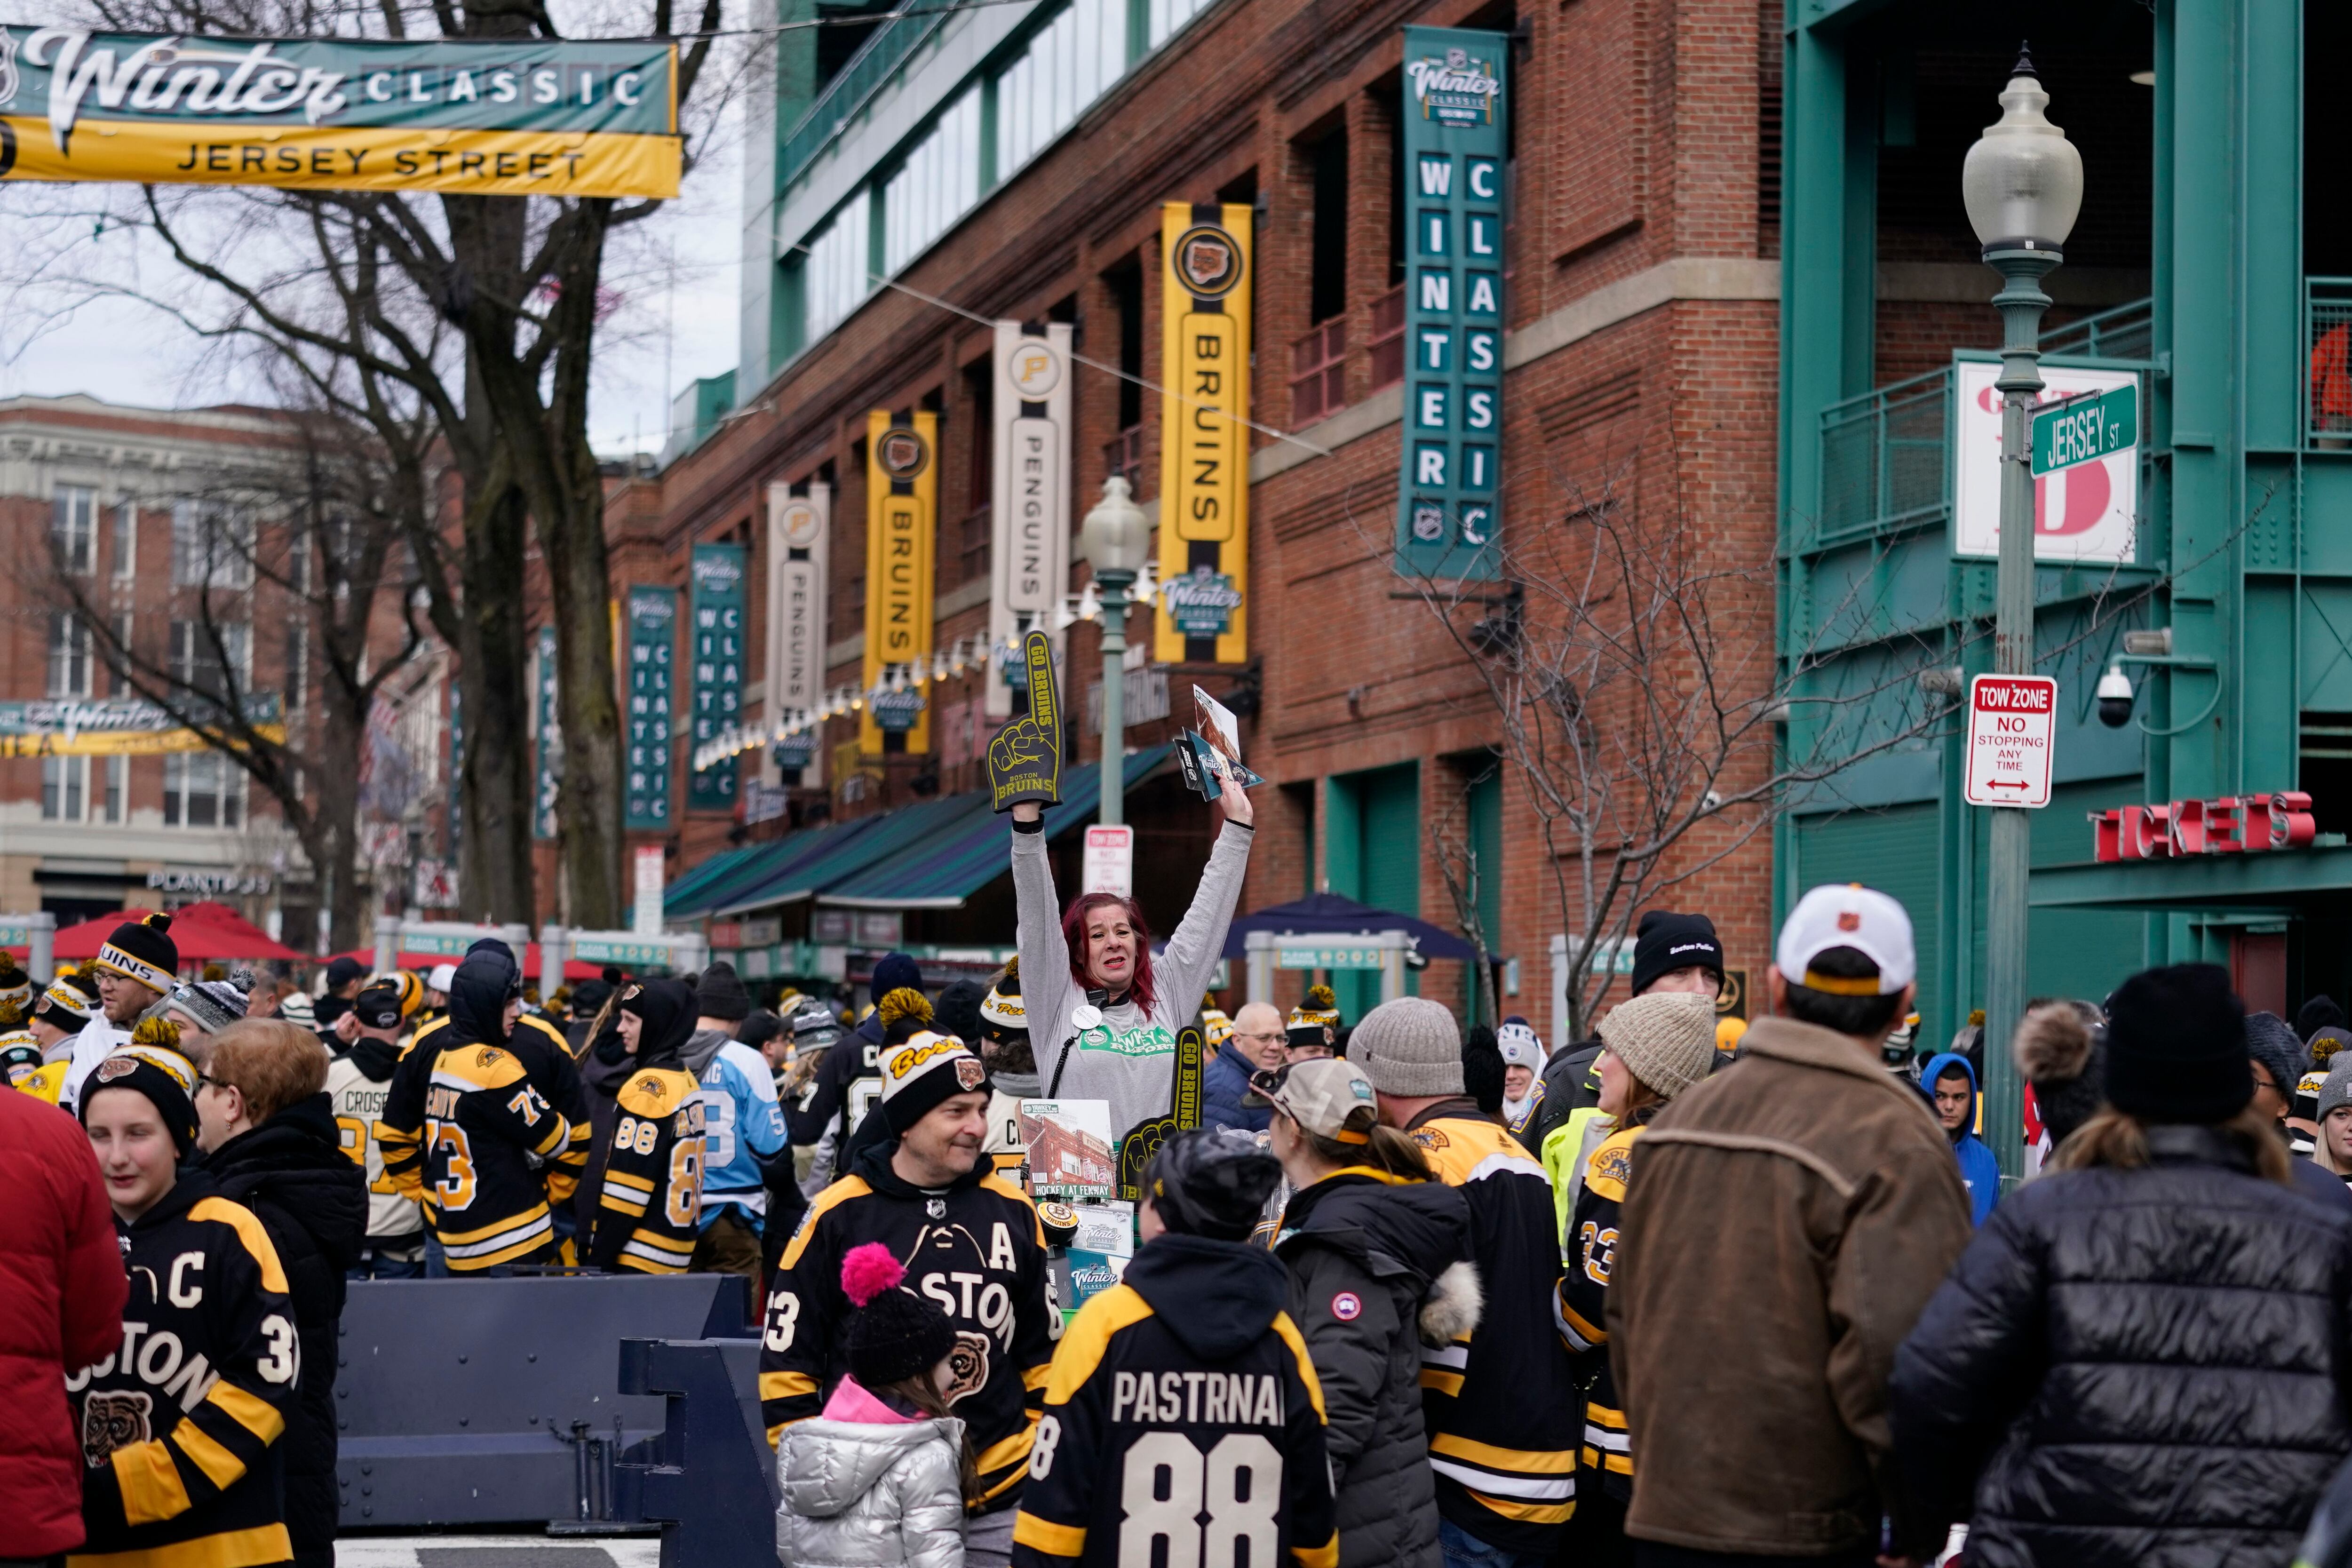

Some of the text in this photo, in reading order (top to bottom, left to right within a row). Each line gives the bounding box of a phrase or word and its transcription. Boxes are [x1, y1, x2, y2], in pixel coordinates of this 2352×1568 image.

[24, 28, 641, 151] Winter CLASSIC
[1407, 61, 1500, 103] Winter
[176, 144, 585, 181] JERSEY STREET
[1419, 161, 1452, 486] WINTER
[1464, 163, 1494, 545] CLASSIC
[1192, 334, 1221, 522] BRUINS
[2048, 406, 2120, 470] JERSEY ST
[1022, 436, 1042, 597] PENGUINS
[889, 511, 912, 650] BRUINS
[1161, 579, 1242, 618] Winter
[789, 574, 807, 699] PENGUINS
[1030, 645, 1053, 726] GO BRUINS
[1979, 686, 2048, 709] TOW ZONE
[631, 644, 650, 793] WINTER
[650, 644, 670, 819] CLASSIC
[1978, 735, 2044, 748] STOPPING
[1997, 717, 2026, 732] NO
[1199, 754, 1222, 772] Winter
[1996, 761, 2023, 771] TIME
[1998, 749, 2022, 759] ANY
[998, 778, 1054, 801] BRUINS
[1009, 772, 1038, 783] BOSTON
[1091, 833, 1127, 846] TOW ZONE
[2087, 792, 2315, 863] TICKETS
[1669, 943, 1715, 955] Boston Police
[1180, 1042, 1197, 1130] GO BRUINS
[614, 1116, 658, 1156] 88
[1087, 1138, 1105, 1152] FENWAY
[1036, 1185, 1110, 1196] HOCKEY AT FENWAY
[1053, 1205, 1065, 1215] B
[1046, 1216, 1072, 1226] BRUINS
[1077, 1225, 1122, 1241] Winter
[988, 1222, 1016, 1273] A
[168, 1251, 205, 1309] C
[1071, 1269, 1118, 1289] Winter
[761, 1290, 800, 1353] 3
[256, 1314, 301, 1391] 3
[1111, 1371, 1286, 1426] PASTRNA
[1028, 1414, 1061, 1481] 8
[1117, 1431, 1284, 1568] 88
